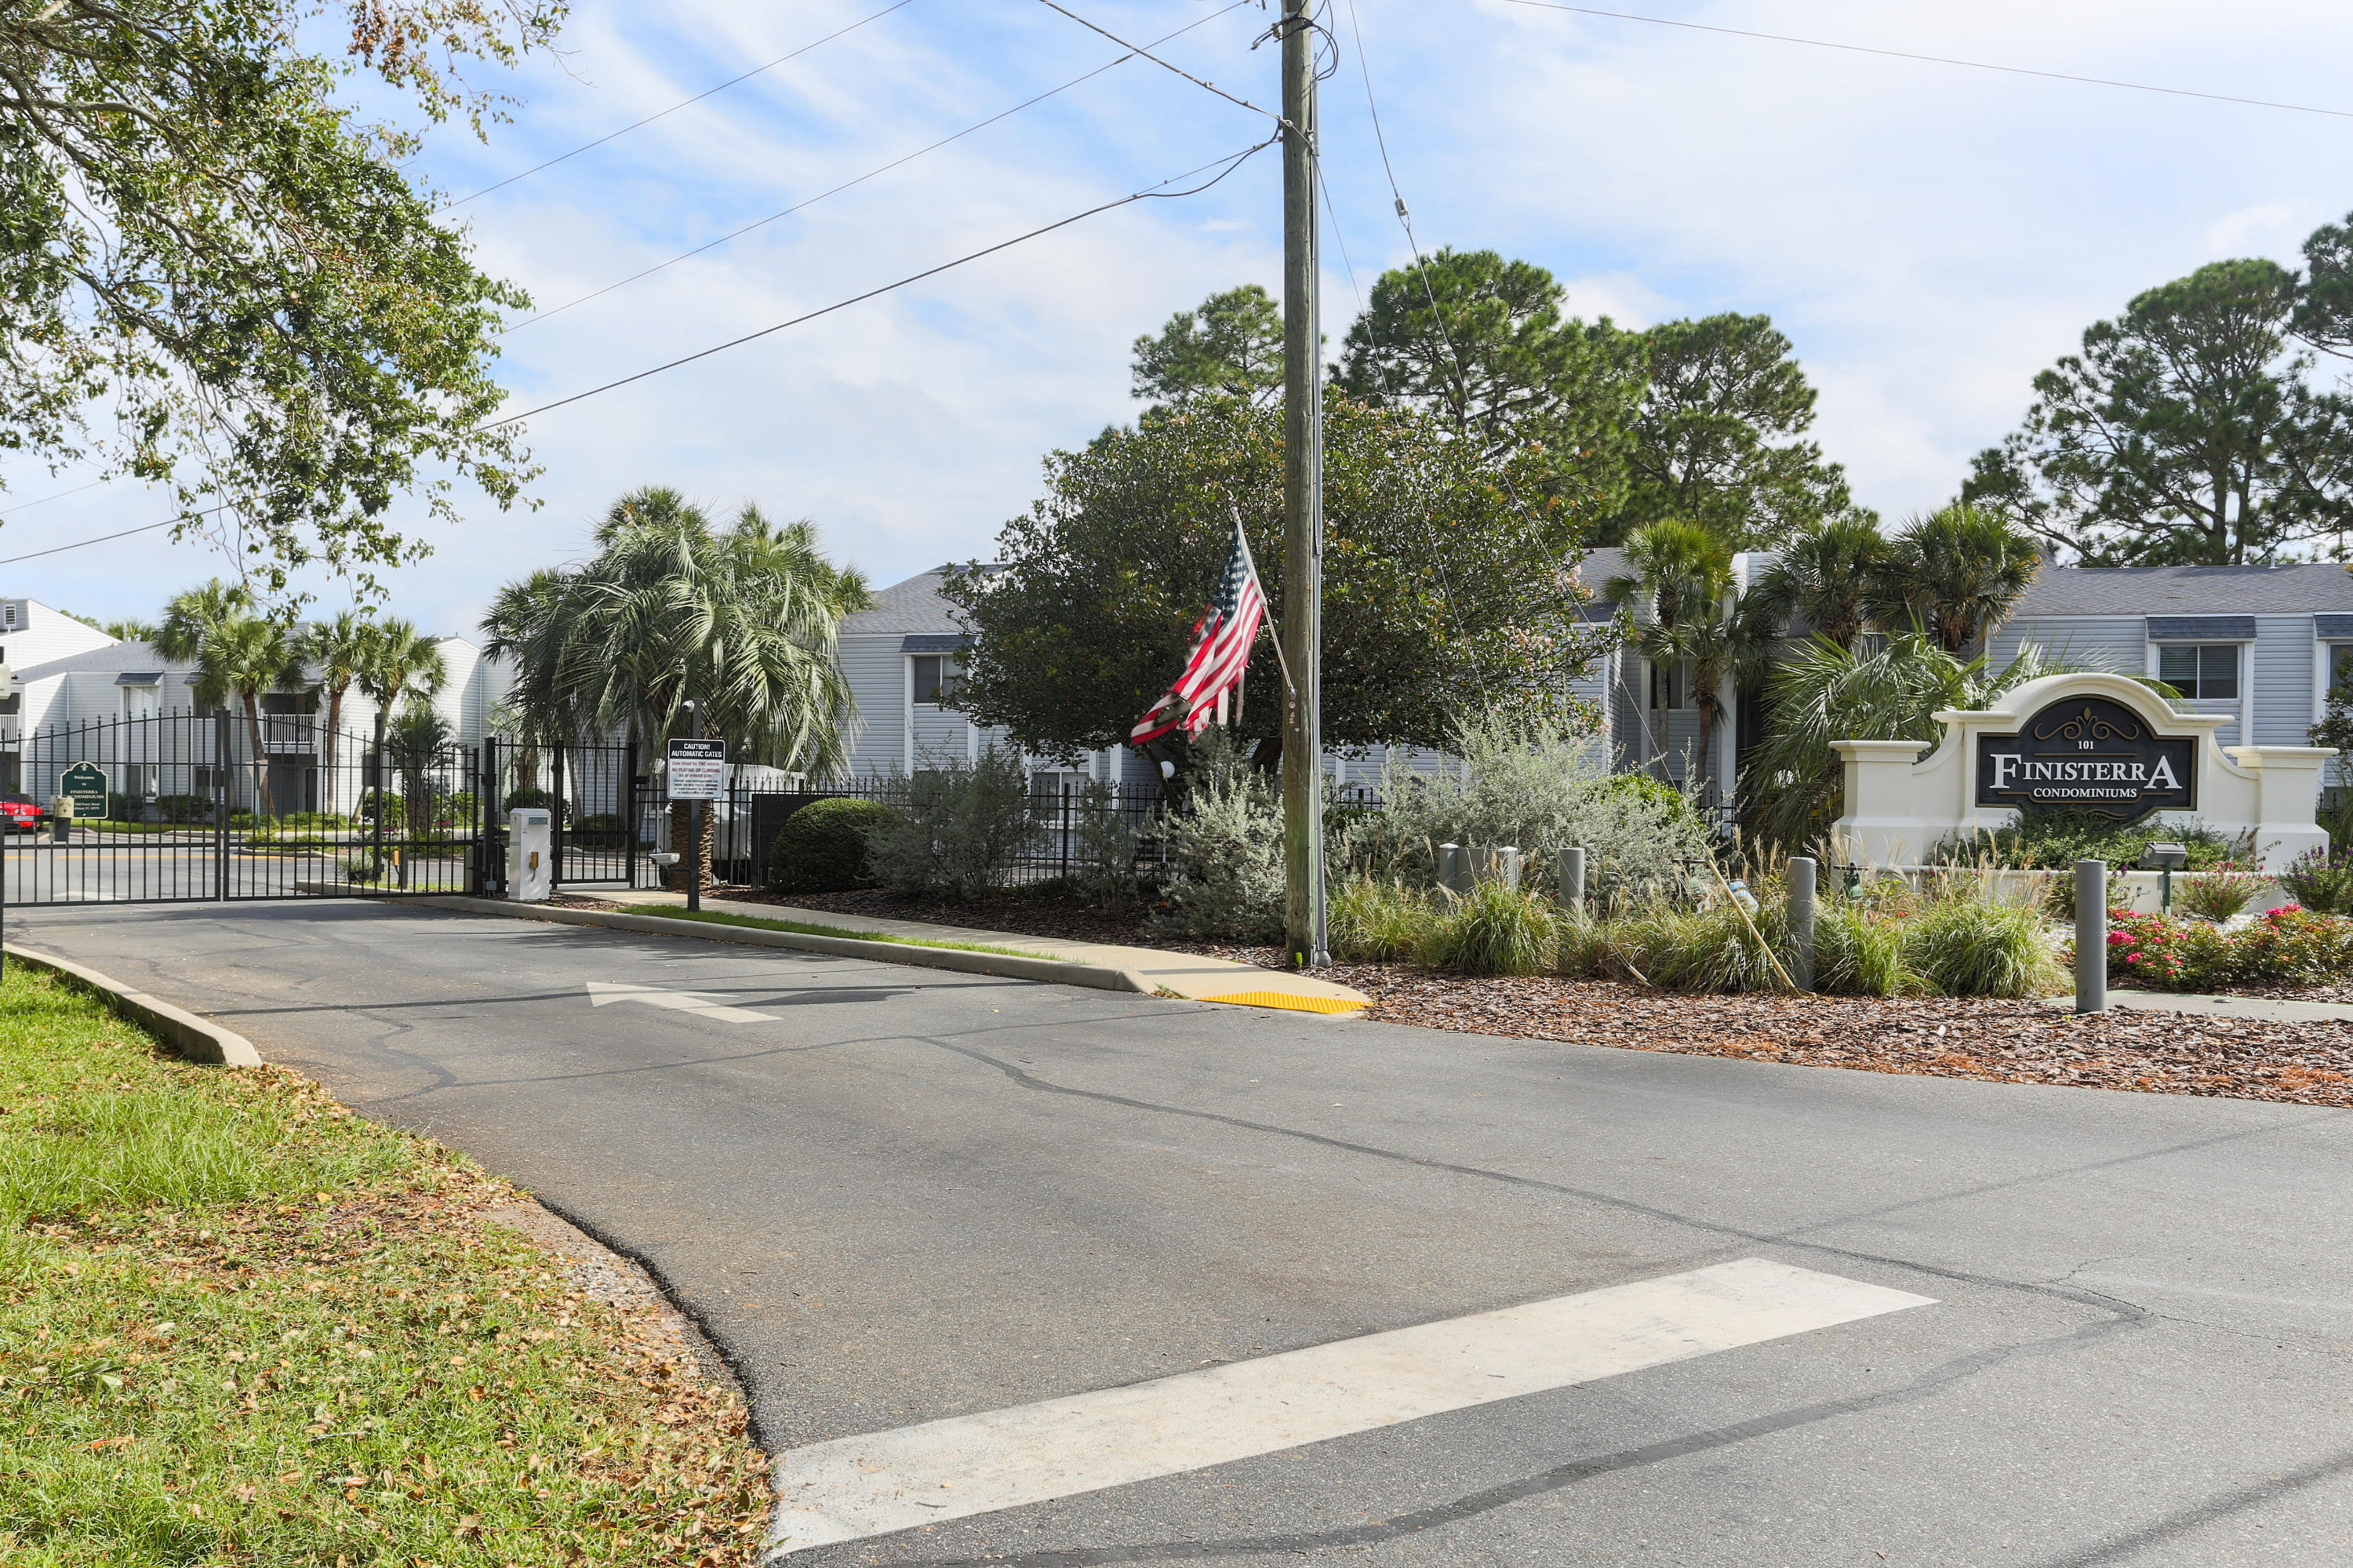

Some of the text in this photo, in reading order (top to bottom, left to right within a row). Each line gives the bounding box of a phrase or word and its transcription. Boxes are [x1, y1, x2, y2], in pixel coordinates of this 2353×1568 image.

[2078, 740, 2094, 750] 101
[1989, 754, 2183, 789] FINISTERRA
[2033, 788, 2137, 798] CONDOMINIUMS
